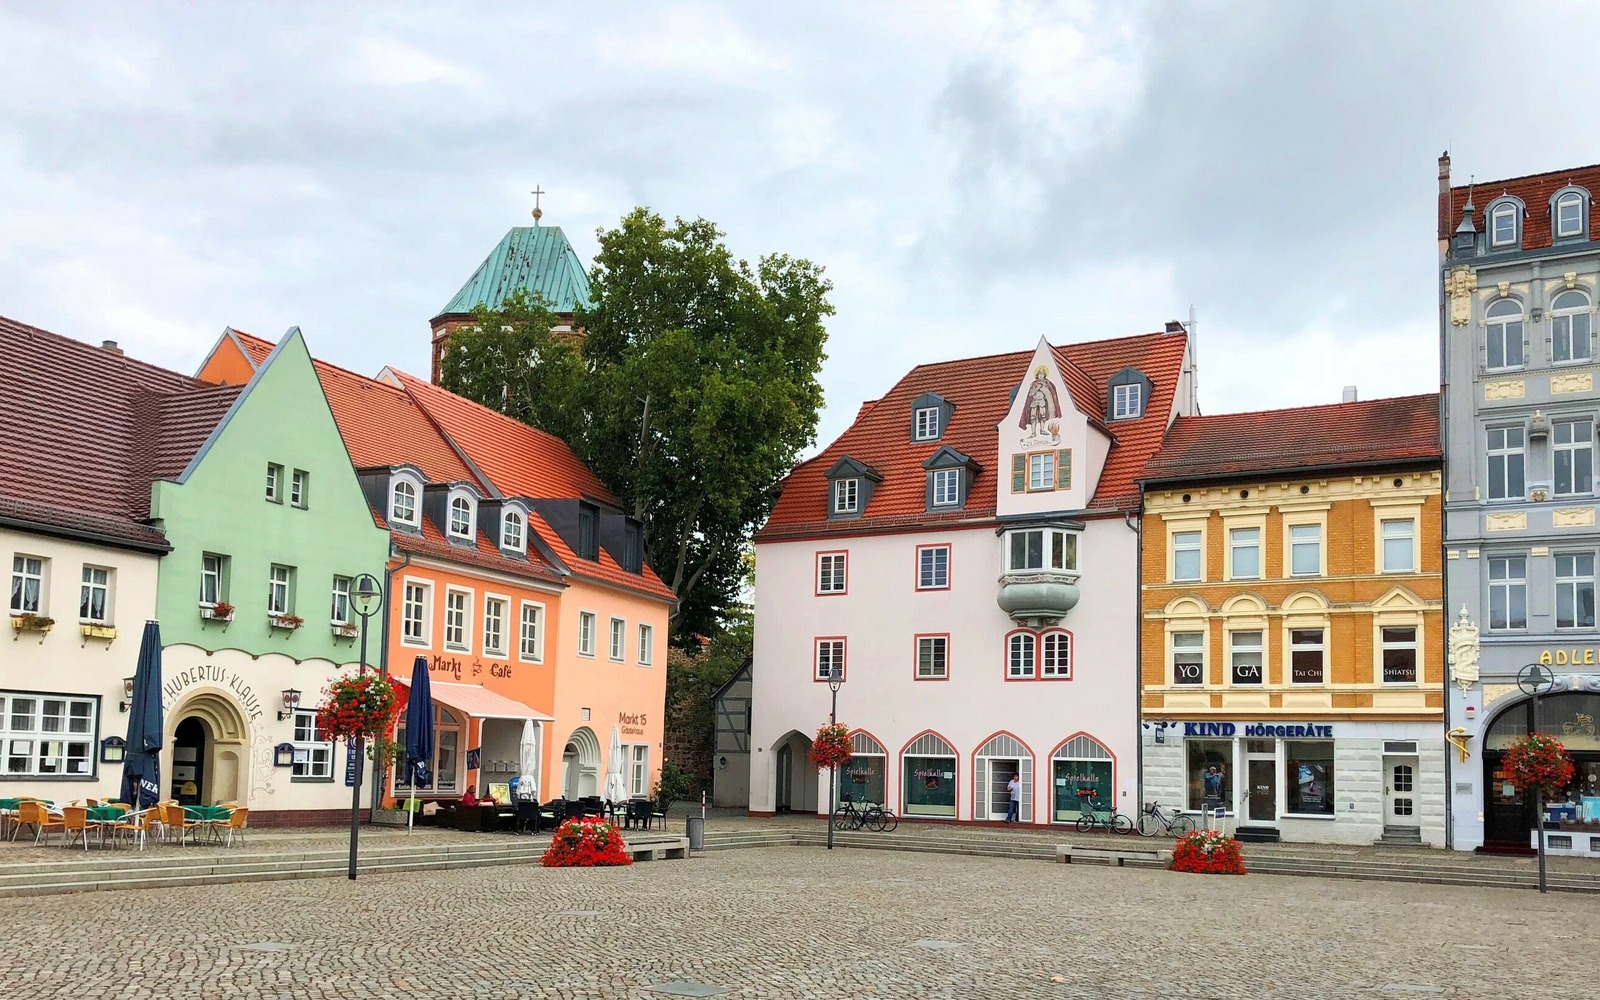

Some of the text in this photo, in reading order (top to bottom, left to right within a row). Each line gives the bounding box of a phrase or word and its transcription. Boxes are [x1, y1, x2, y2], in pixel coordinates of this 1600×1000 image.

[1539, 649, 1600, 665] ADLE
[428, 655, 512, 681] Markt Café
[1179, 665, 1200, 678] YO
[1236, 664, 1260, 678] GA
[163, 665, 263, 721] HUBERTUS KLAUSE
[619, 712, 647, 726] Markt 15
[1184, 722, 1333, 737] KIND HÖRGERÄTE
[846, 767, 875, 779] Spielhalle
[914, 768, 944, 780] Spielhalle
[1065, 773, 1099, 785] Spielhalle
